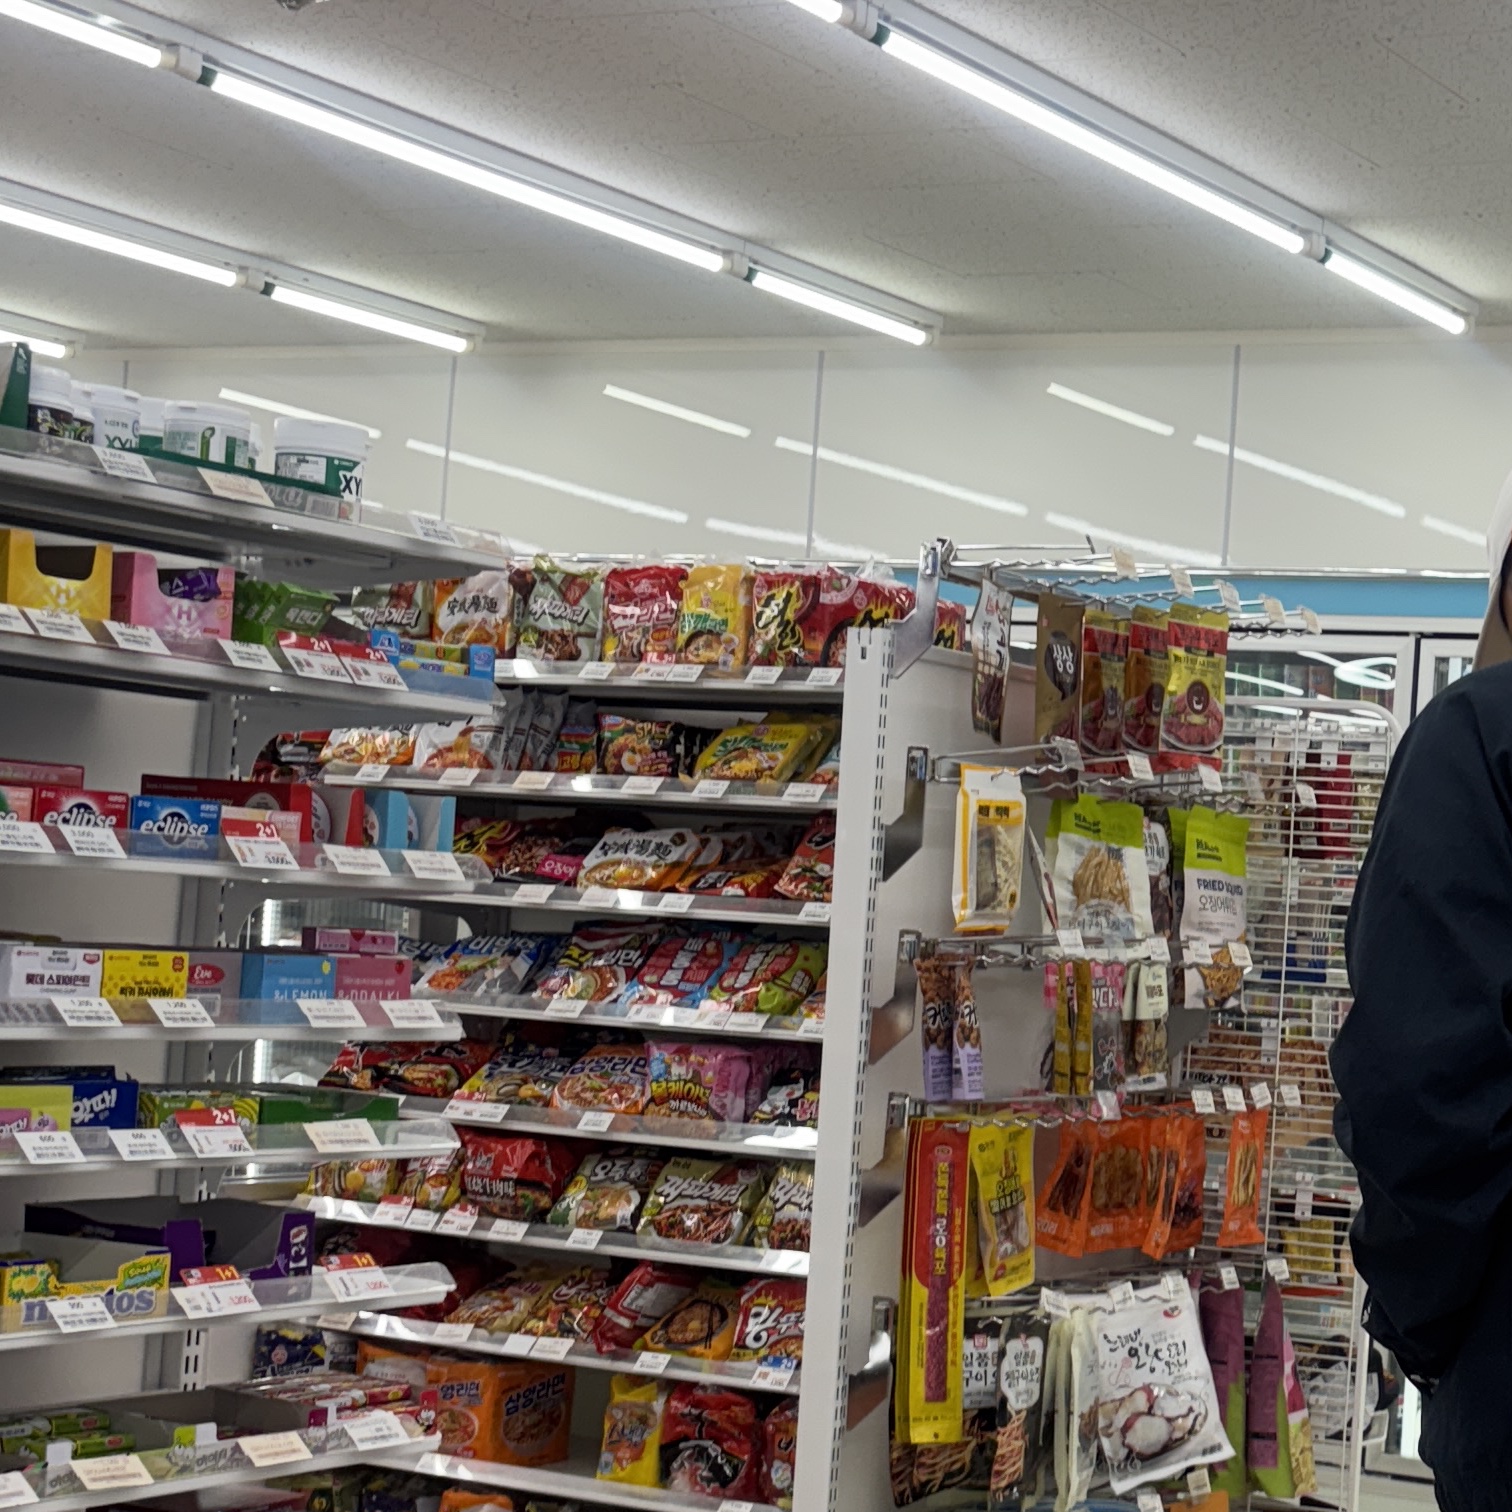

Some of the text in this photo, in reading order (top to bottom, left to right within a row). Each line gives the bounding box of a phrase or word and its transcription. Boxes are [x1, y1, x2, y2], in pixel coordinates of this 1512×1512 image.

[310, 638, 333, 652] 2+1
[366, 648, 387, 662] 2+1
[44, 808, 117, 830] eclipse
[140, 818, 209, 843] eclipse
[256, 823, 279, 838] 2+1
[212, 1109, 237, 1125] 2+1
[657, 1175, 748, 1206] 짜파게티
[354, 1253, 377, 1267] 1+1
[215, 1266, 240, 1280] 1+1
[22, 1287, 157, 1325] mtos
[440, 1380, 481, 1401] 양라면
